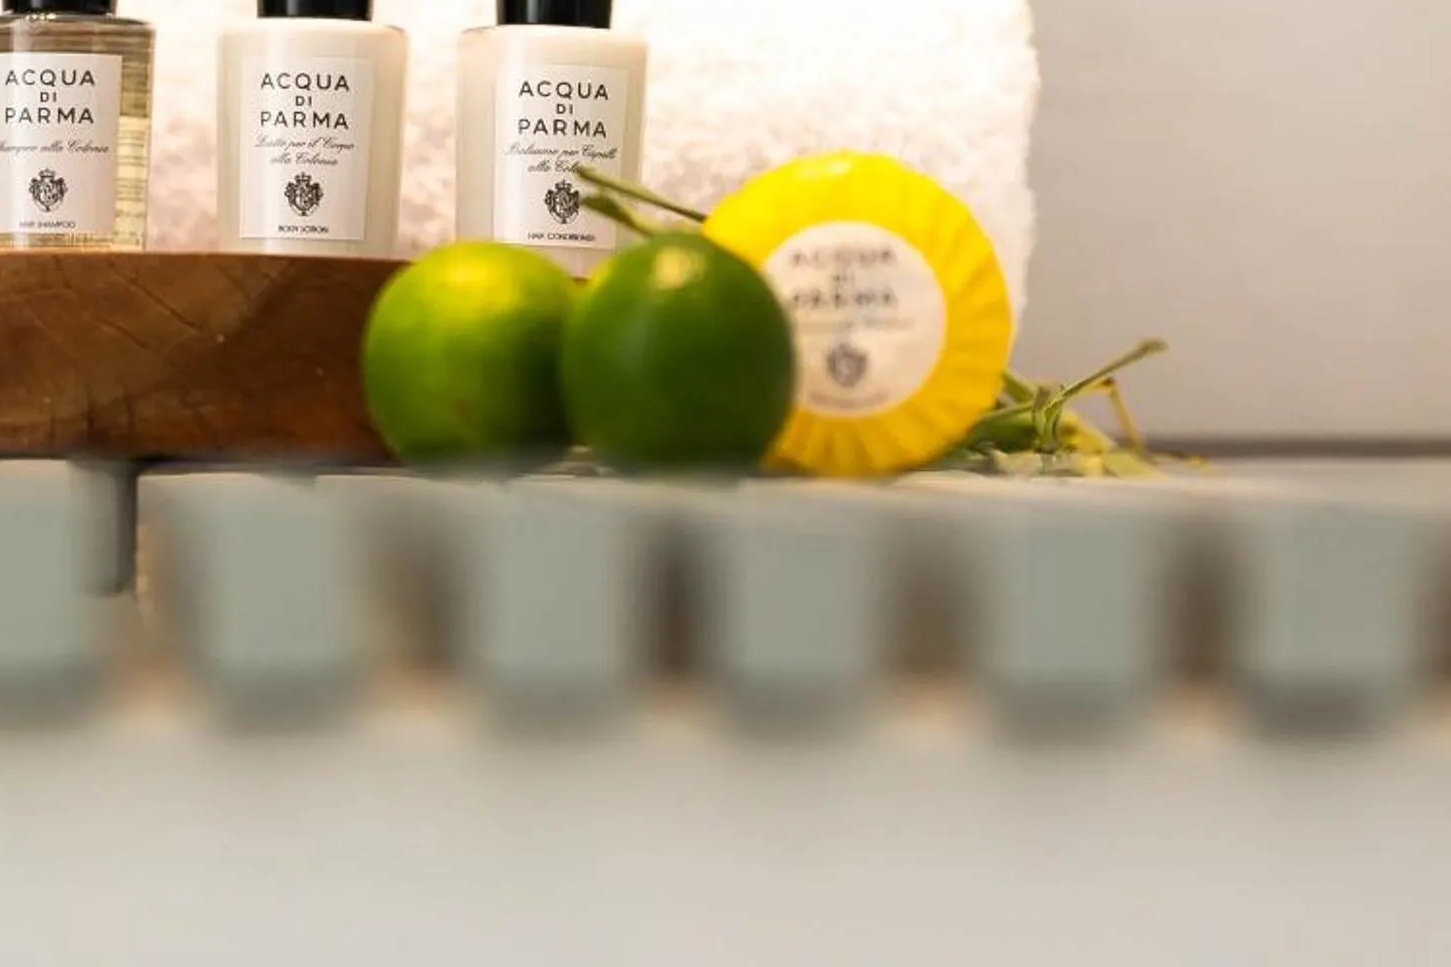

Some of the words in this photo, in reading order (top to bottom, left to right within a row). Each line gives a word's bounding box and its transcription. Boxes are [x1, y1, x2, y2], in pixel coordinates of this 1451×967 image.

[5, 69, 95, 87] ACQUA
[260, 73, 350, 91] ACQUA
[40, 92, 57, 103] DI
[518, 80, 609, 100] ACQUA
[295, 96, 312, 107] DI
[556, 103, 574, 115] DI
[5, 107, 94, 124] PARMA
[260, 111, 349, 130] PARMA
[517, 119, 607, 138] PARMA
